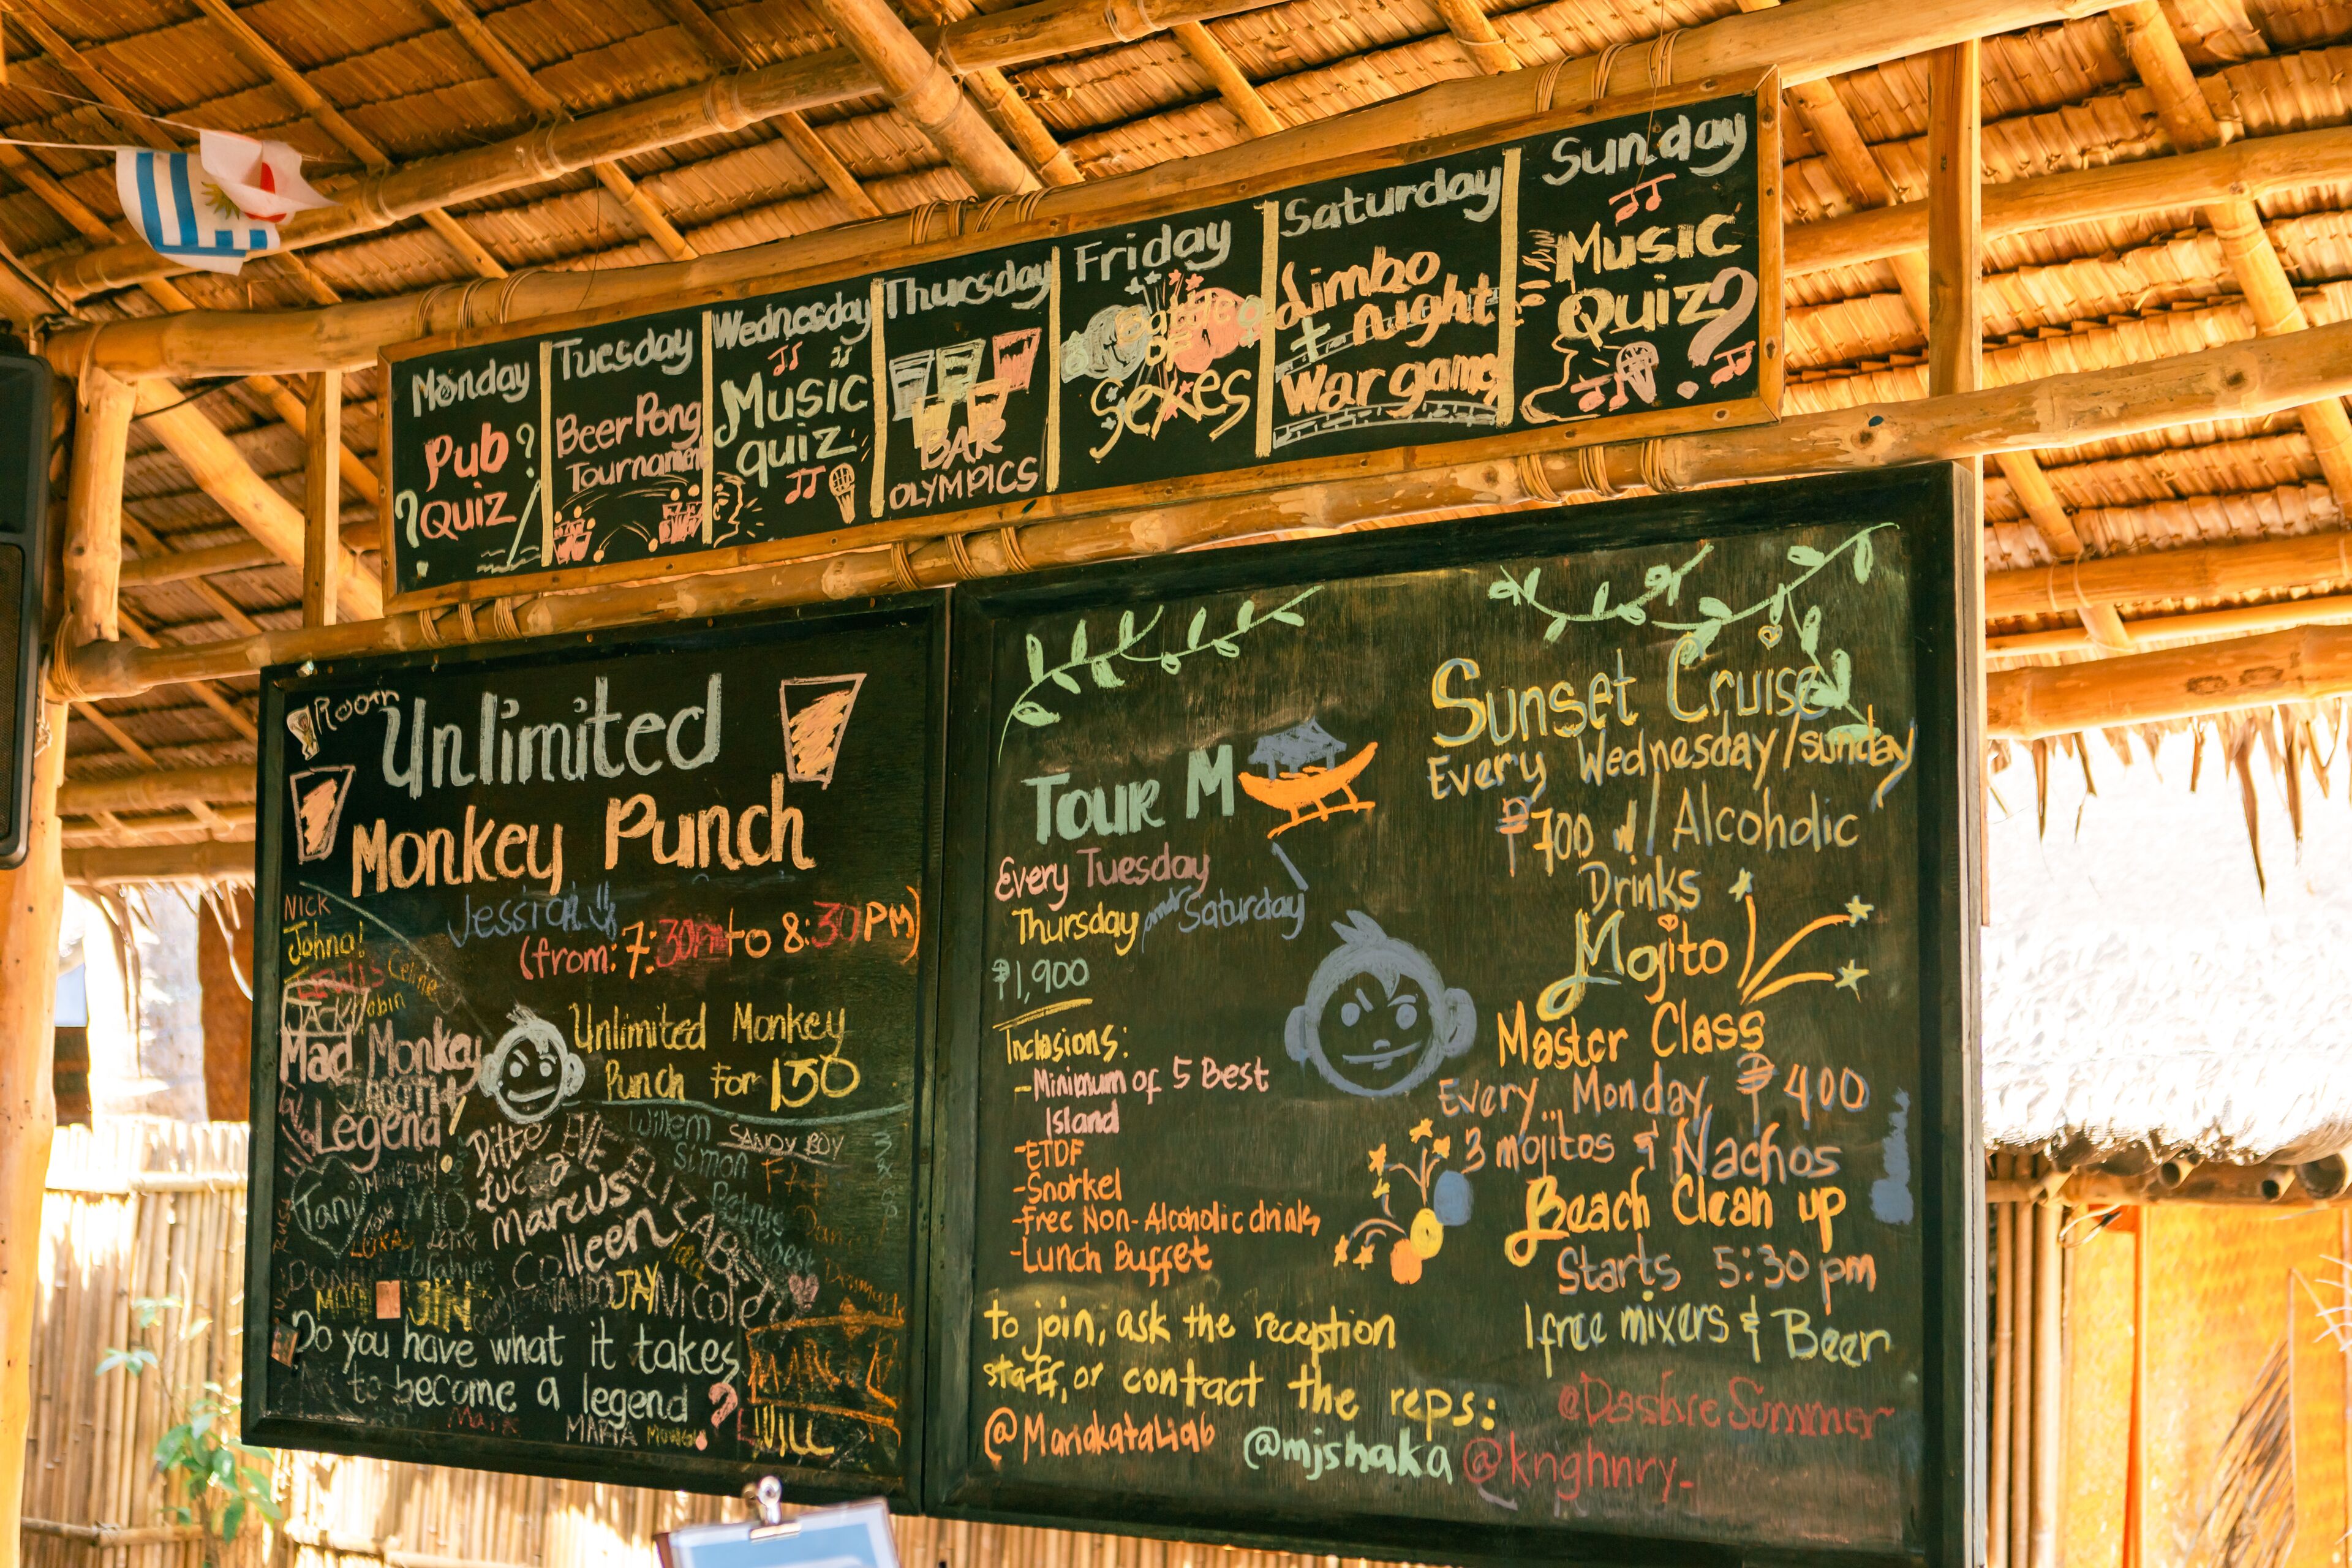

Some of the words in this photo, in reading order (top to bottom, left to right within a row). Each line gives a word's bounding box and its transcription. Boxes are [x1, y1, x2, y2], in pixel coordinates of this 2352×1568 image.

[1542, 113, 1747, 186] Sunday
[1280, 166, 1501, 237] Saturday
[1074, 220, 1231, 282] Friday
[1555, 214, 1743, 283] Music
[712, 292, 872, 349] Wednesday
[883, 260, 1051, 318] Thursday
[551, 327, 693, 380] Tuesday
[412, 359, 530, 418] Monday
[714, 372, 868, 448] Music
[1281, 363, 1386, 416] War
[424, 423, 509, 492] Pub
[556, 413, 633, 459] Beer
[636, 392, 702, 450] Pong
[921, 418, 1006, 470] BAR
[890, 457, 1039, 510] OLYMPICS
[1431, 648, 1639, 748] Sunset
[1666, 635, 1830, 723] Cruise
[380, 673, 722, 800] Unlimited
[1185, 744, 1234, 819] M
[1427, 751, 1547, 804] Every
[352, 805, 563, 898] Monkey
[605, 773, 816, 870] Punch
[1672, 780, 1859, 852] Alcoholic
[284, 893, 332, 921] NICK
[994, 856, 1069, 912] Every
[1077, 842, 1211, 897] Tuesday
[1577, 854, 1702, 914] Drinks
[726, 908, 771, 958] to
[1012, 901, 1140, 957] Thursday
[1178, 886, 1306, 940] Saturday
[1536, 908, 1728, 1022] Mojito
[279, 1022, 353, 1084] Mad
[368, 1015, 484, 1096] Monkey
[568, 1001, 706, 1052] Unlimited
[733, 1003, 854, 1057] Monkey
[1498, 1000, 1628, 1069] Master
[1651, 998, 1766, 1058] Class
[605, 1058, 685, 1102] Punch
[771, 1054, 861, 1112] 150
[1132, 1068, 1162, 1105] of
[1172, 1056, 1193, 1089] 5
[1201, 1056, 1270, 1093] Best
[1437, 1077, 1539, 1144] Every
[1572, 1061, 1709, 1136] Monday
[1046, 1098, 1120, 1139] Island
[1461, 1126, 1486, 1175] 3
[1496, 1109, 1615, 1177] mojitos
[1670, 1104, 1843, 1186] Nachos
[1504, 1166, 1651, 1267] Beach
[1672, 1172, 1774, 1230] Clean
[1798, 1186, 1846, 1254] up
[1115, 1235, 1213, 1287] Buffet
[1556, 1232, 1681, 1295] Starts
[1713, 1244, 1810, 1289] 5:30
[1820, 1253, 1877, 1316] pm
[342, 1325, 390, 1374] you
[402, 1314, 478, 1368] have
[490, 1325, 566, 1367] what
[590, 1316, 617, 1370] it
[632, 1322, 740, 1384] takes
[983, 1298, 1019, 1340] to
[1022, 1295, 1106, 1362] join,
[1116, 1298, 1171, 1344] ask
[1182, 1302, 1236, 1343] the
[1254, 1305, 1396, 1368] reception
[1620, 1291, 1730, 1346] mixers
[1770, 1307, 1894, 1368] Beer
[393, 1364, 517, 1414] become
[537, 1376, 560, 1411] a
[583, 1372, 688, 1431] legend
[1073, 1361, 1104, 1390] or
[1122, 1358, 1265, 1408] contact
[1287, 1363, 1360, 1421] the
[1390, 1386, 1497, 1442] reps:
[1243, 1426, 1453, 1485] @mjshaka
